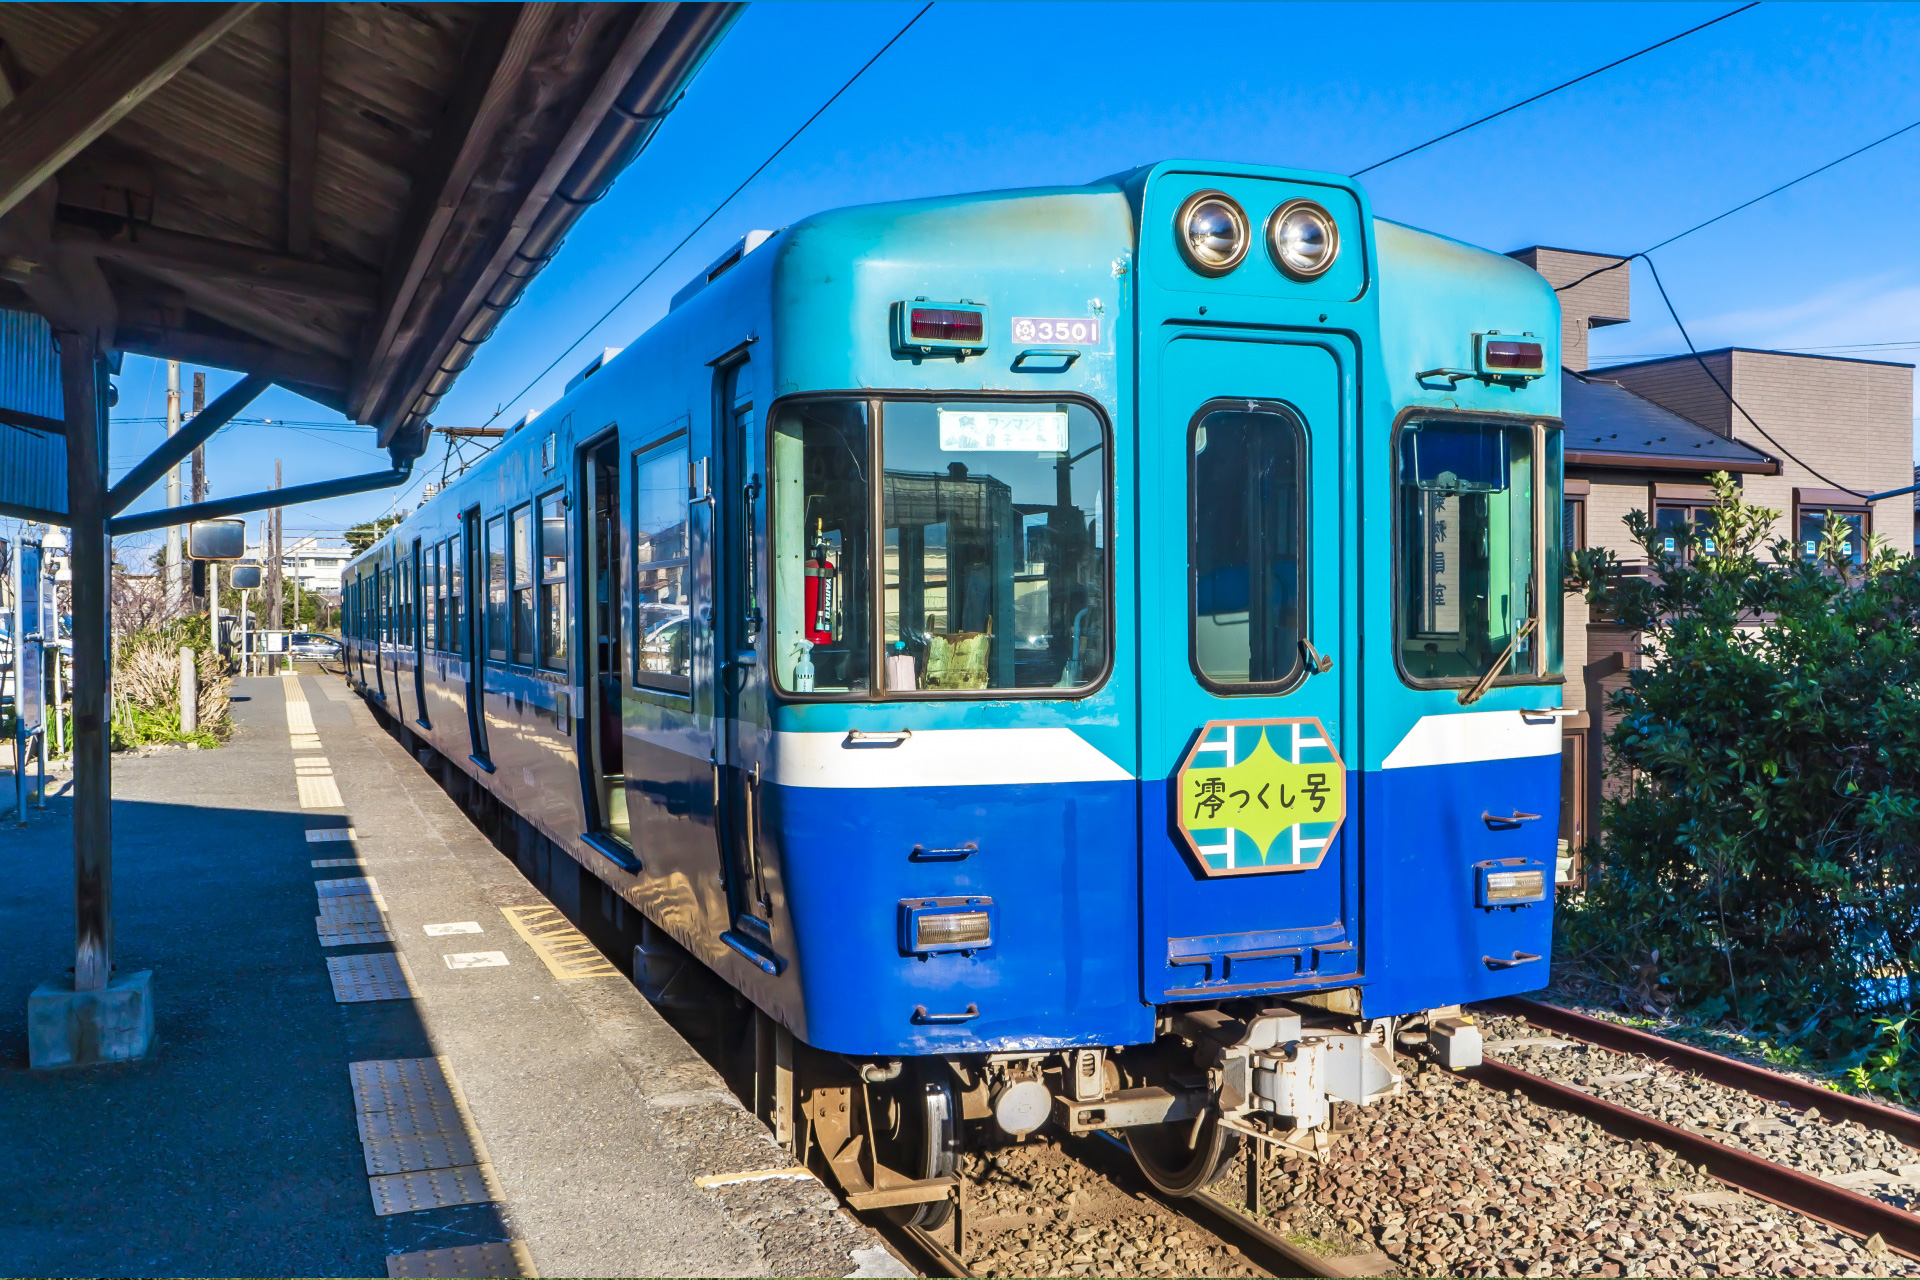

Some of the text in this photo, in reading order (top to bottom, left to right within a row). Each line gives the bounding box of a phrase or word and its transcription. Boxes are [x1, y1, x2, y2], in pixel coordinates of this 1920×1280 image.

[1038, 322, 1097, 341] 3501
[1194, 773, 1331, 819] 澪つくし号
